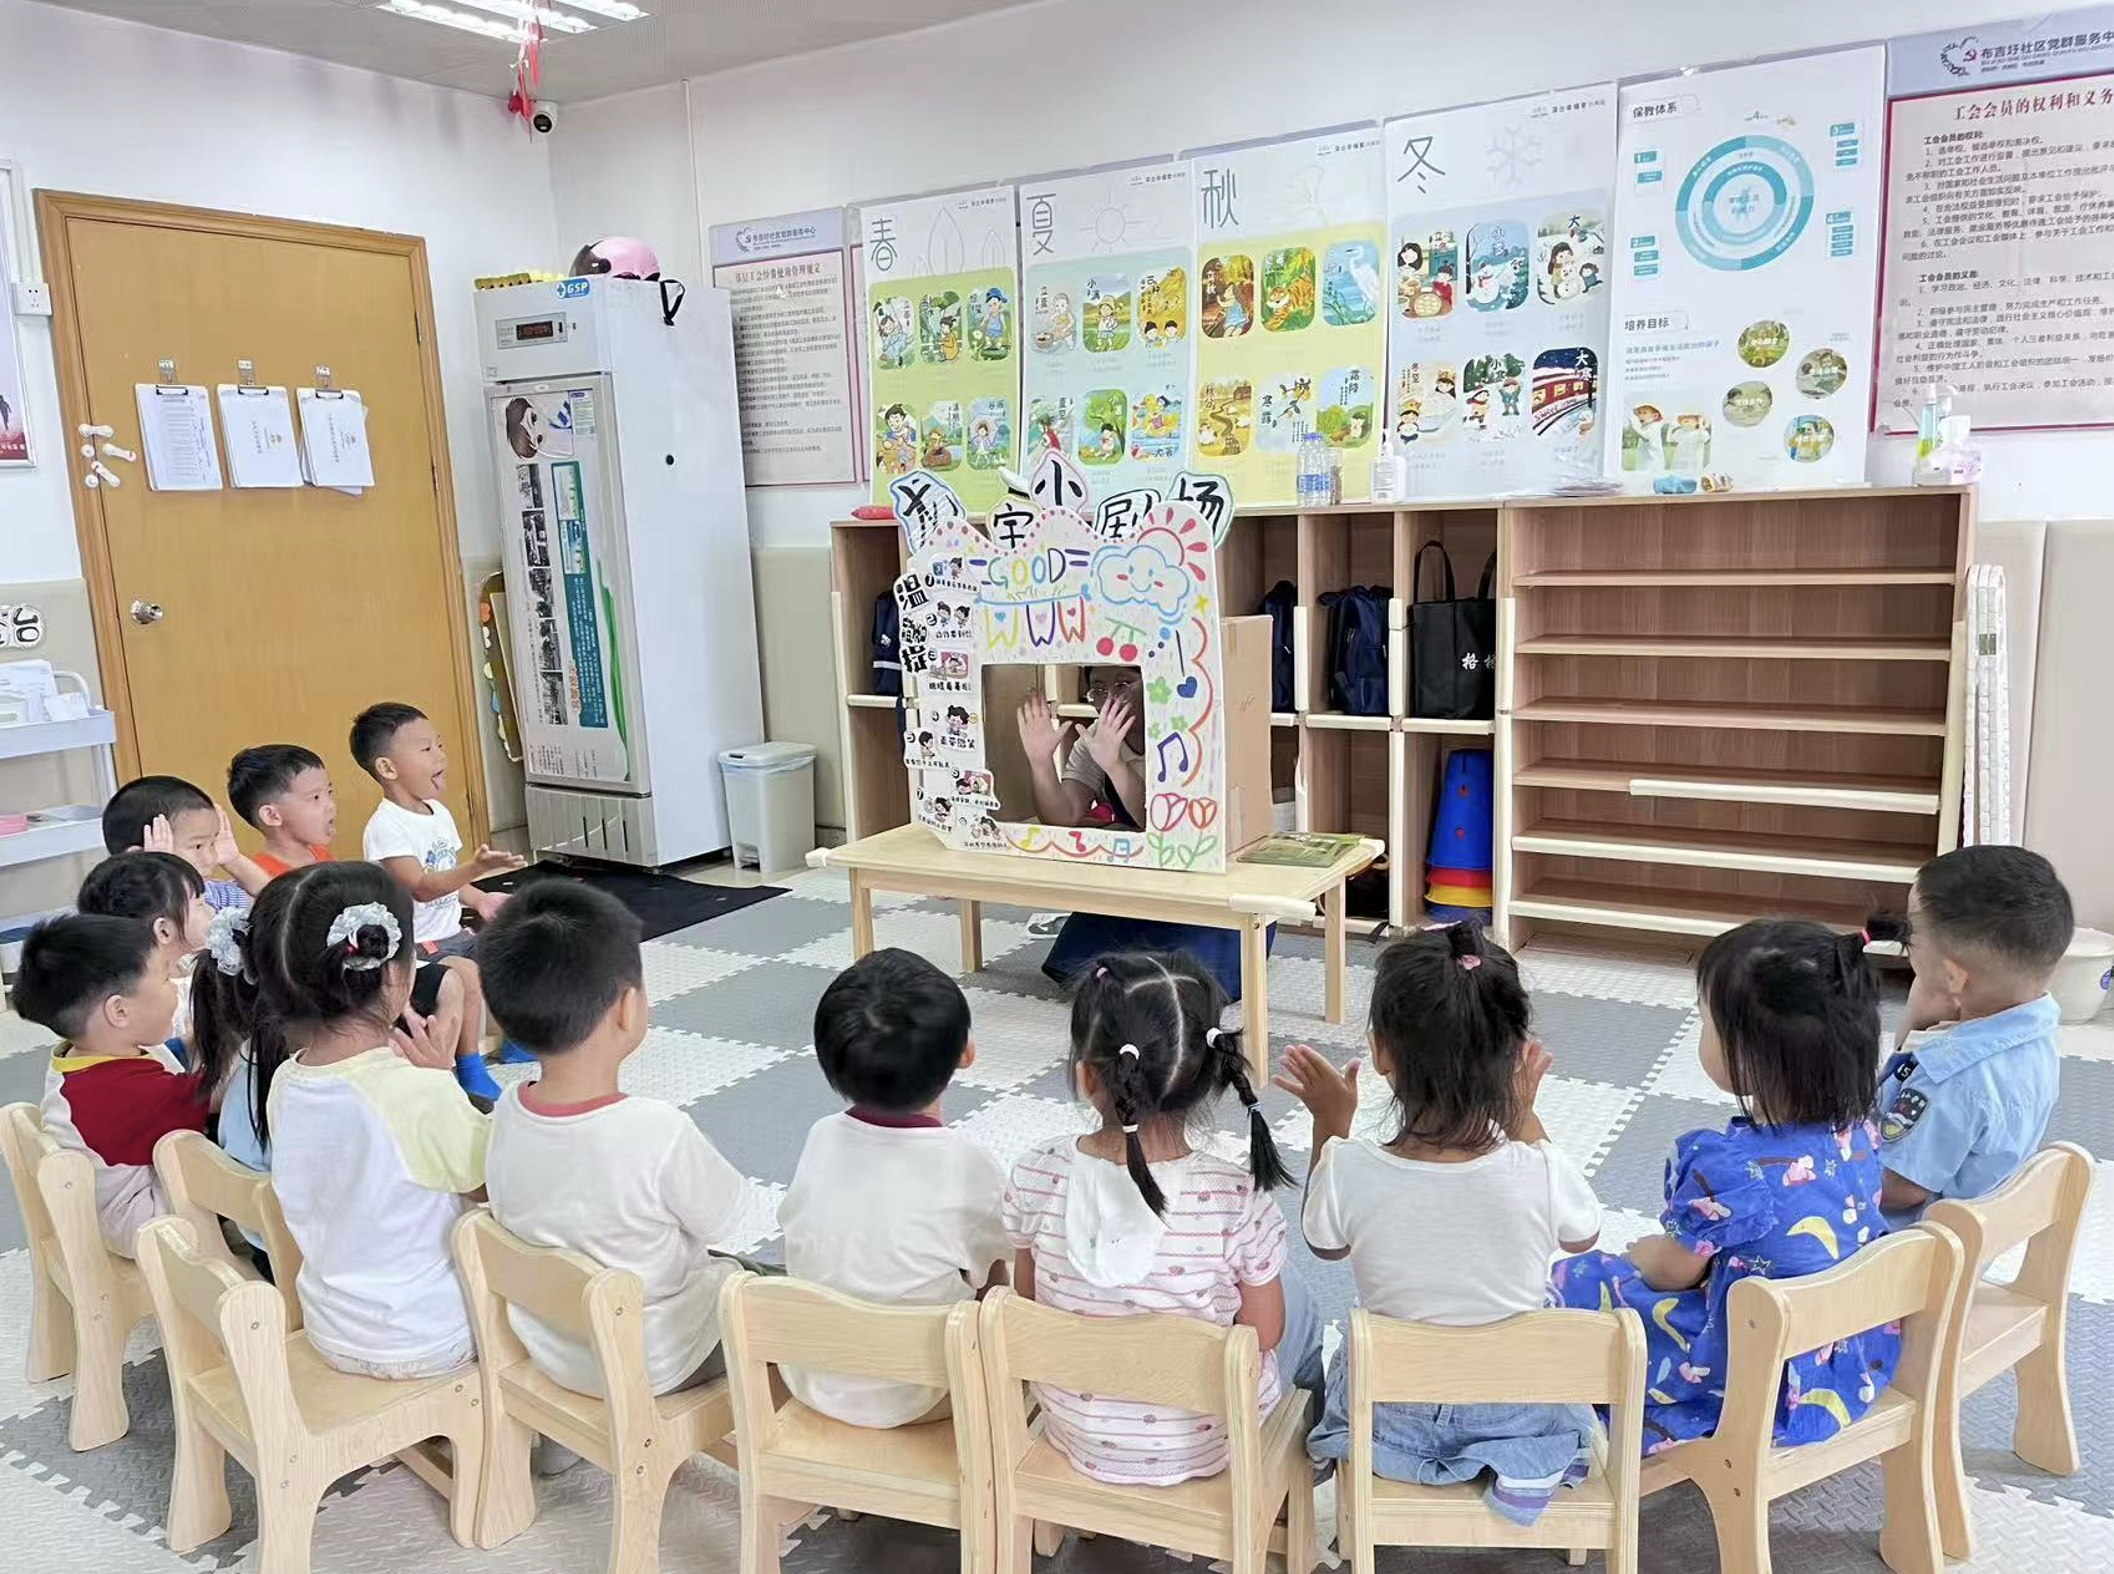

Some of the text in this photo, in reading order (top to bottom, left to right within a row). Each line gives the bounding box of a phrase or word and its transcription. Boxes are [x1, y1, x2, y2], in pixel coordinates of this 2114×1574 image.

[1632, 102, 1678, 119] 保教体系
[1954, 88, 2113, 120] 工会会员的权利和义务
[1397, 136, 1446, 194] 冬
[1201, 168, 1239, 229] 秋
[871, 218, 898, 271] 春
[1027, 193, 1056, 256] 夏
[567, 282, 589, 294] GSP
[1624, 317, 1669, 331] 培养目标
[988, 548, 1067, 590] GOOD
